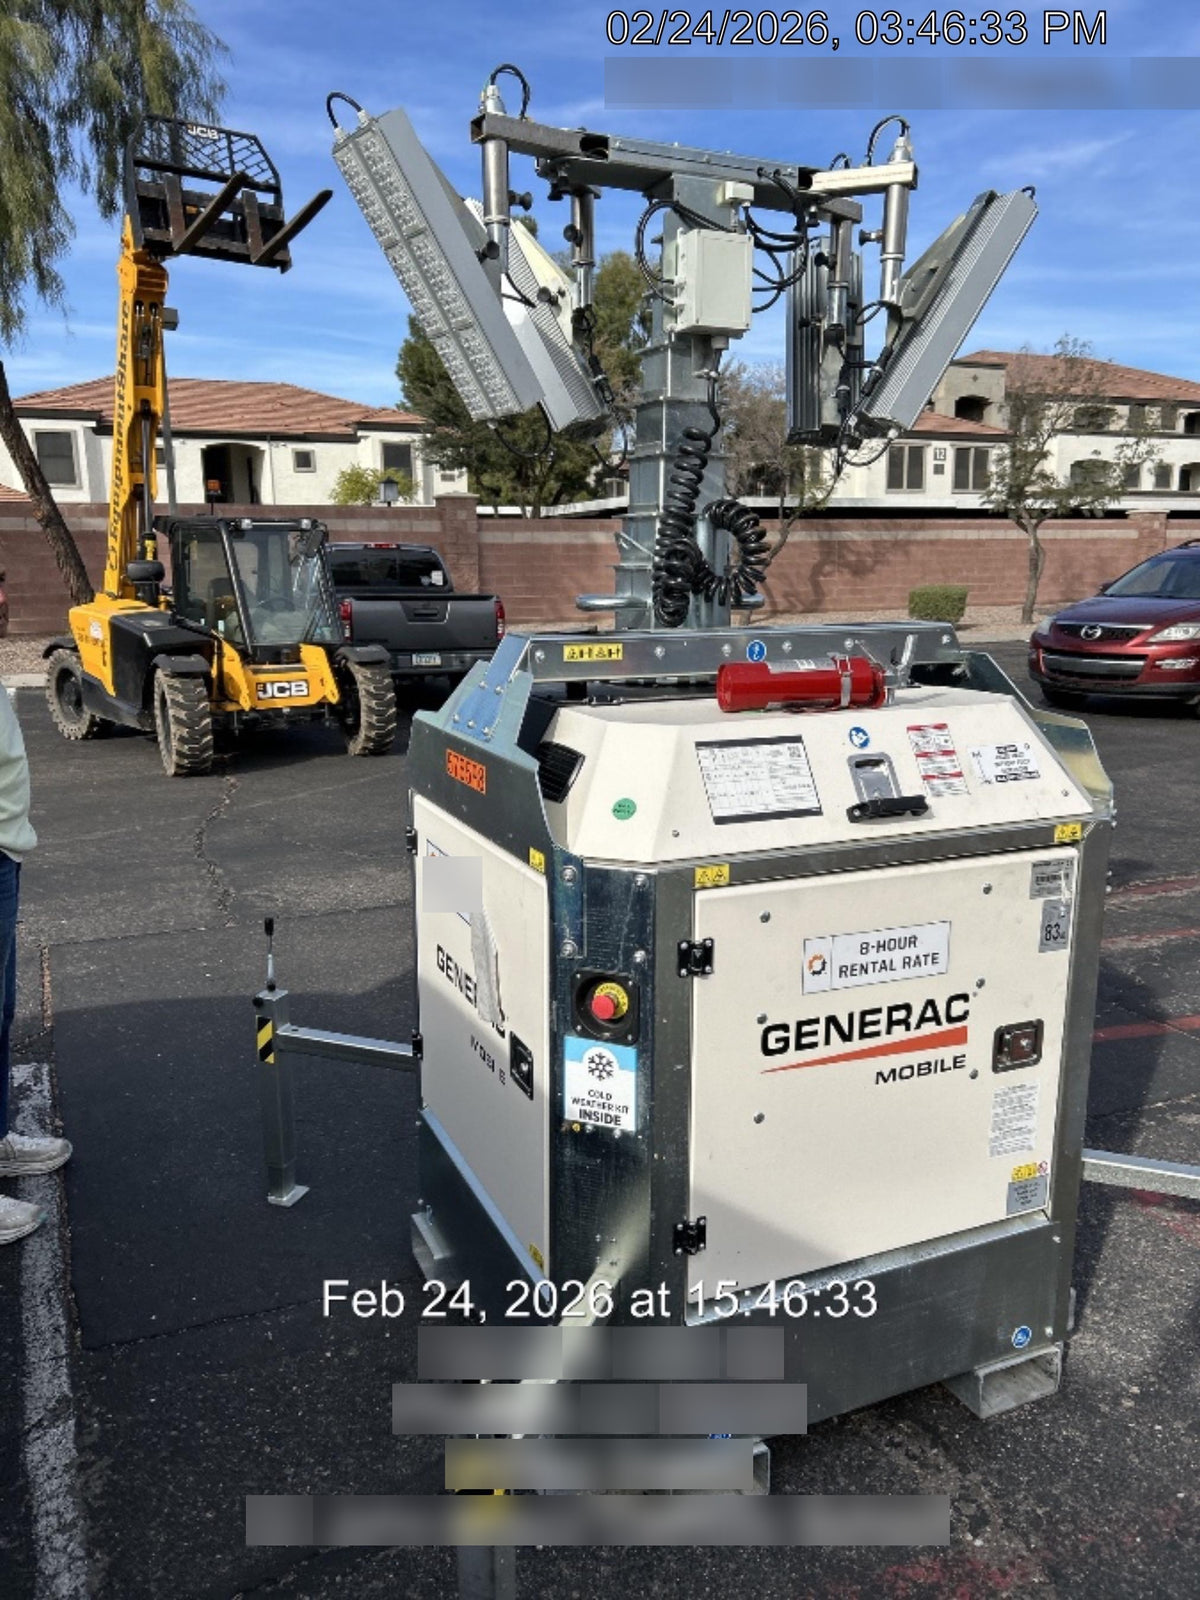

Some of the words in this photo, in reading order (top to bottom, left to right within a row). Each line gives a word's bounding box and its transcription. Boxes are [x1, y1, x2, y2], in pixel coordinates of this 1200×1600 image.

[187, 125, 220, 140] JCB
[256, 680, 309, 699] JCB
[1044, 922, 1061, 942] 83
[859, 934, 919, 956] 8-HOUR
[838, 957, 897, 979] RENTAL
[901, 951, 941, 970] RATE
[436, 943, 506, 1040] GENEC
[760, 992, 971, 1057] GENERAC
[874, 1053, 967, 1085] MOBILE
[587, 1088, 613, 1101] COLD
[578, 1108, 622, 1127] INSIDE
